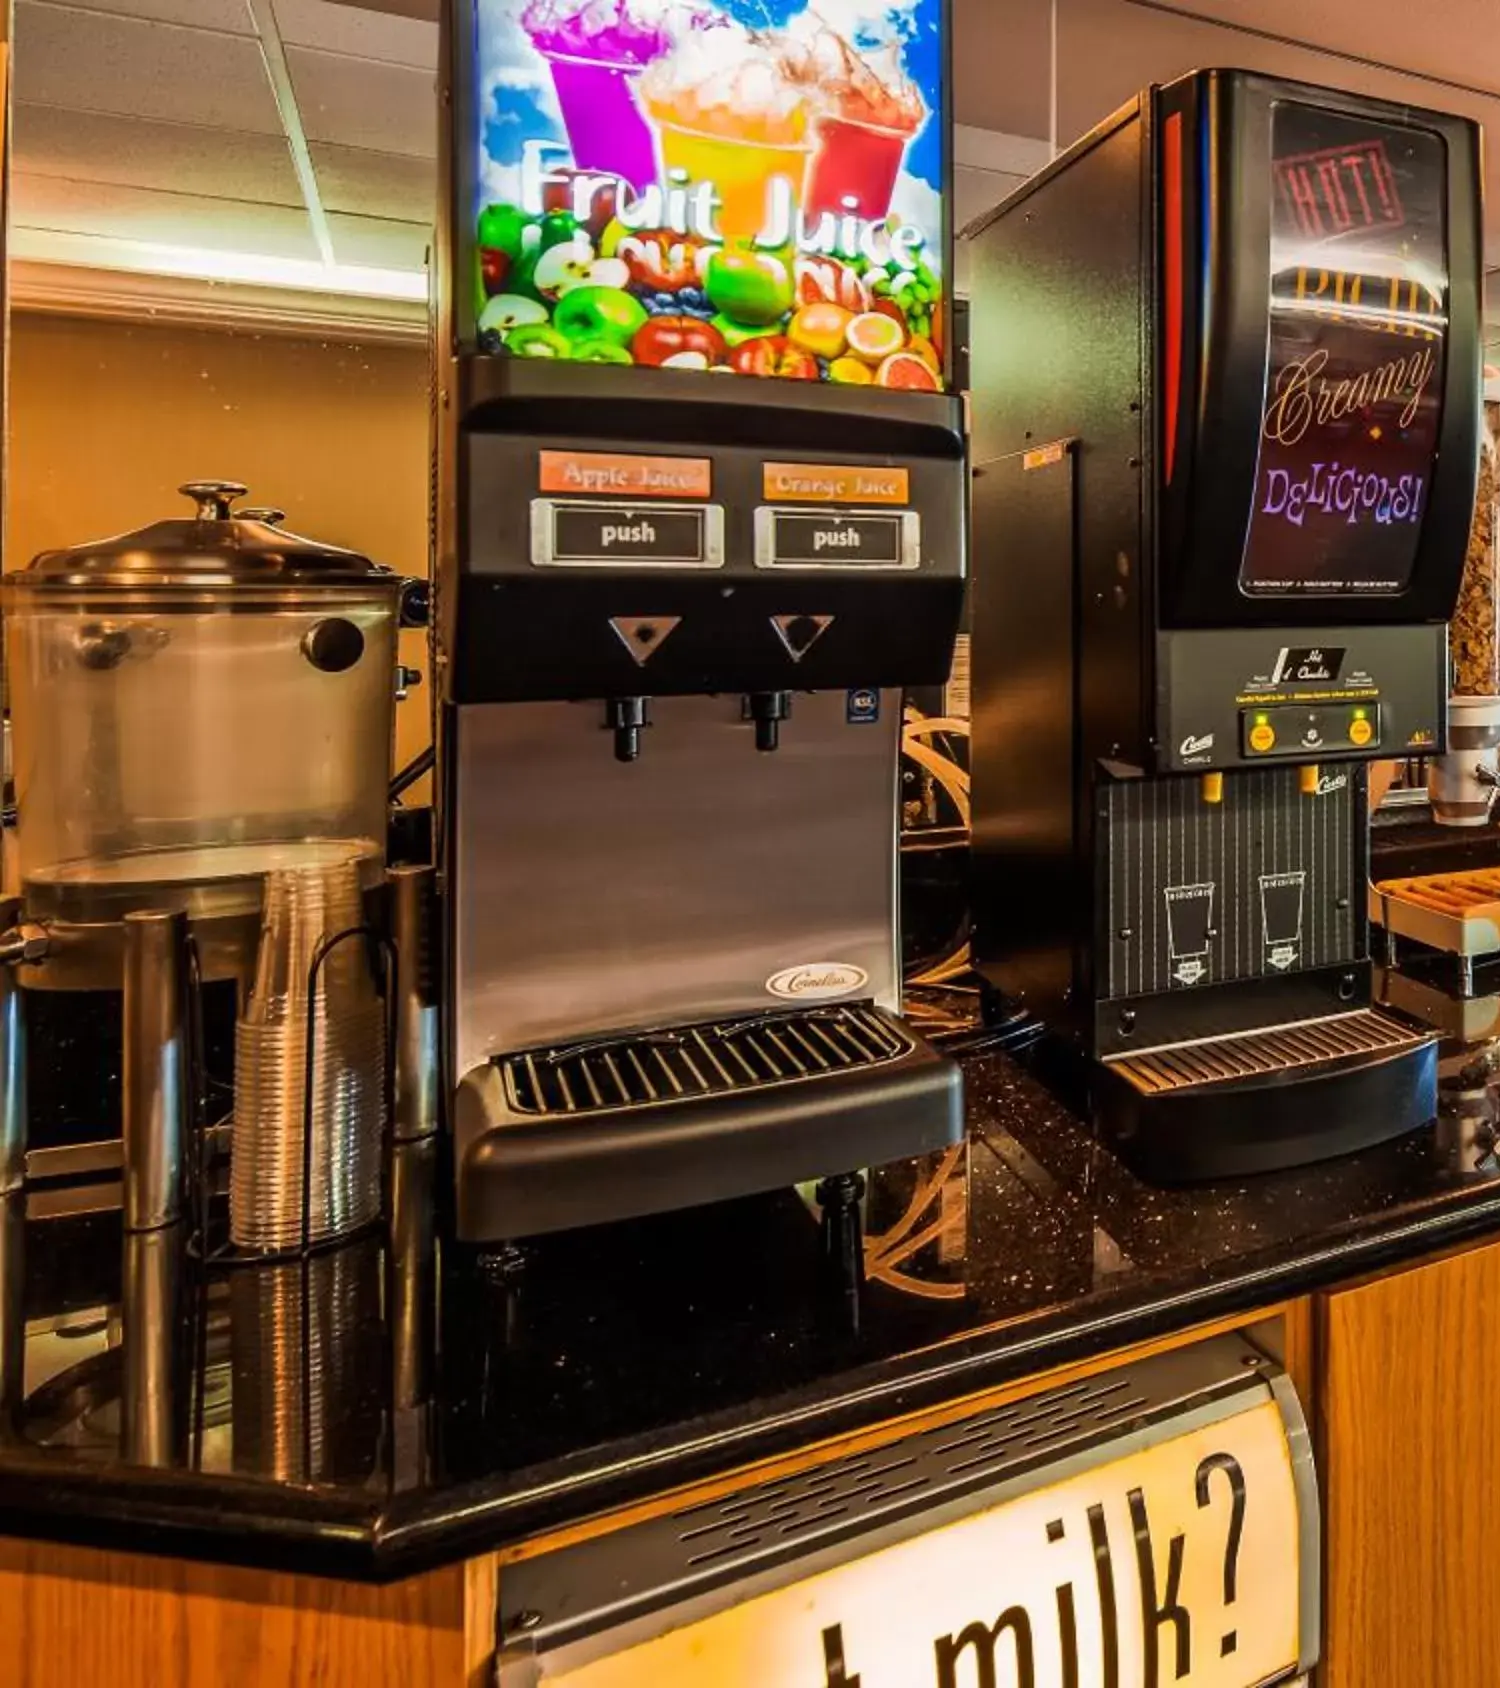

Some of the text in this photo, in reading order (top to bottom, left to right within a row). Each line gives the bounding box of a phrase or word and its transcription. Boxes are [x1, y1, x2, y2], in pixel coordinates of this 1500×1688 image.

[521, 138, 725, 241] Fruit
[753, 175, 927, 271] Juice
[1286, 149, 1397, 238] HOT!
[1263, 346, 1436, 447] Creamy
[562, 461, 628, 490] Apple
[775, 474, 897, 500] Orange Juice
[601, 521, 657, 547] push
[813, 527, 861, 551] push
[933, 1450, 1246, 1688] milk?
